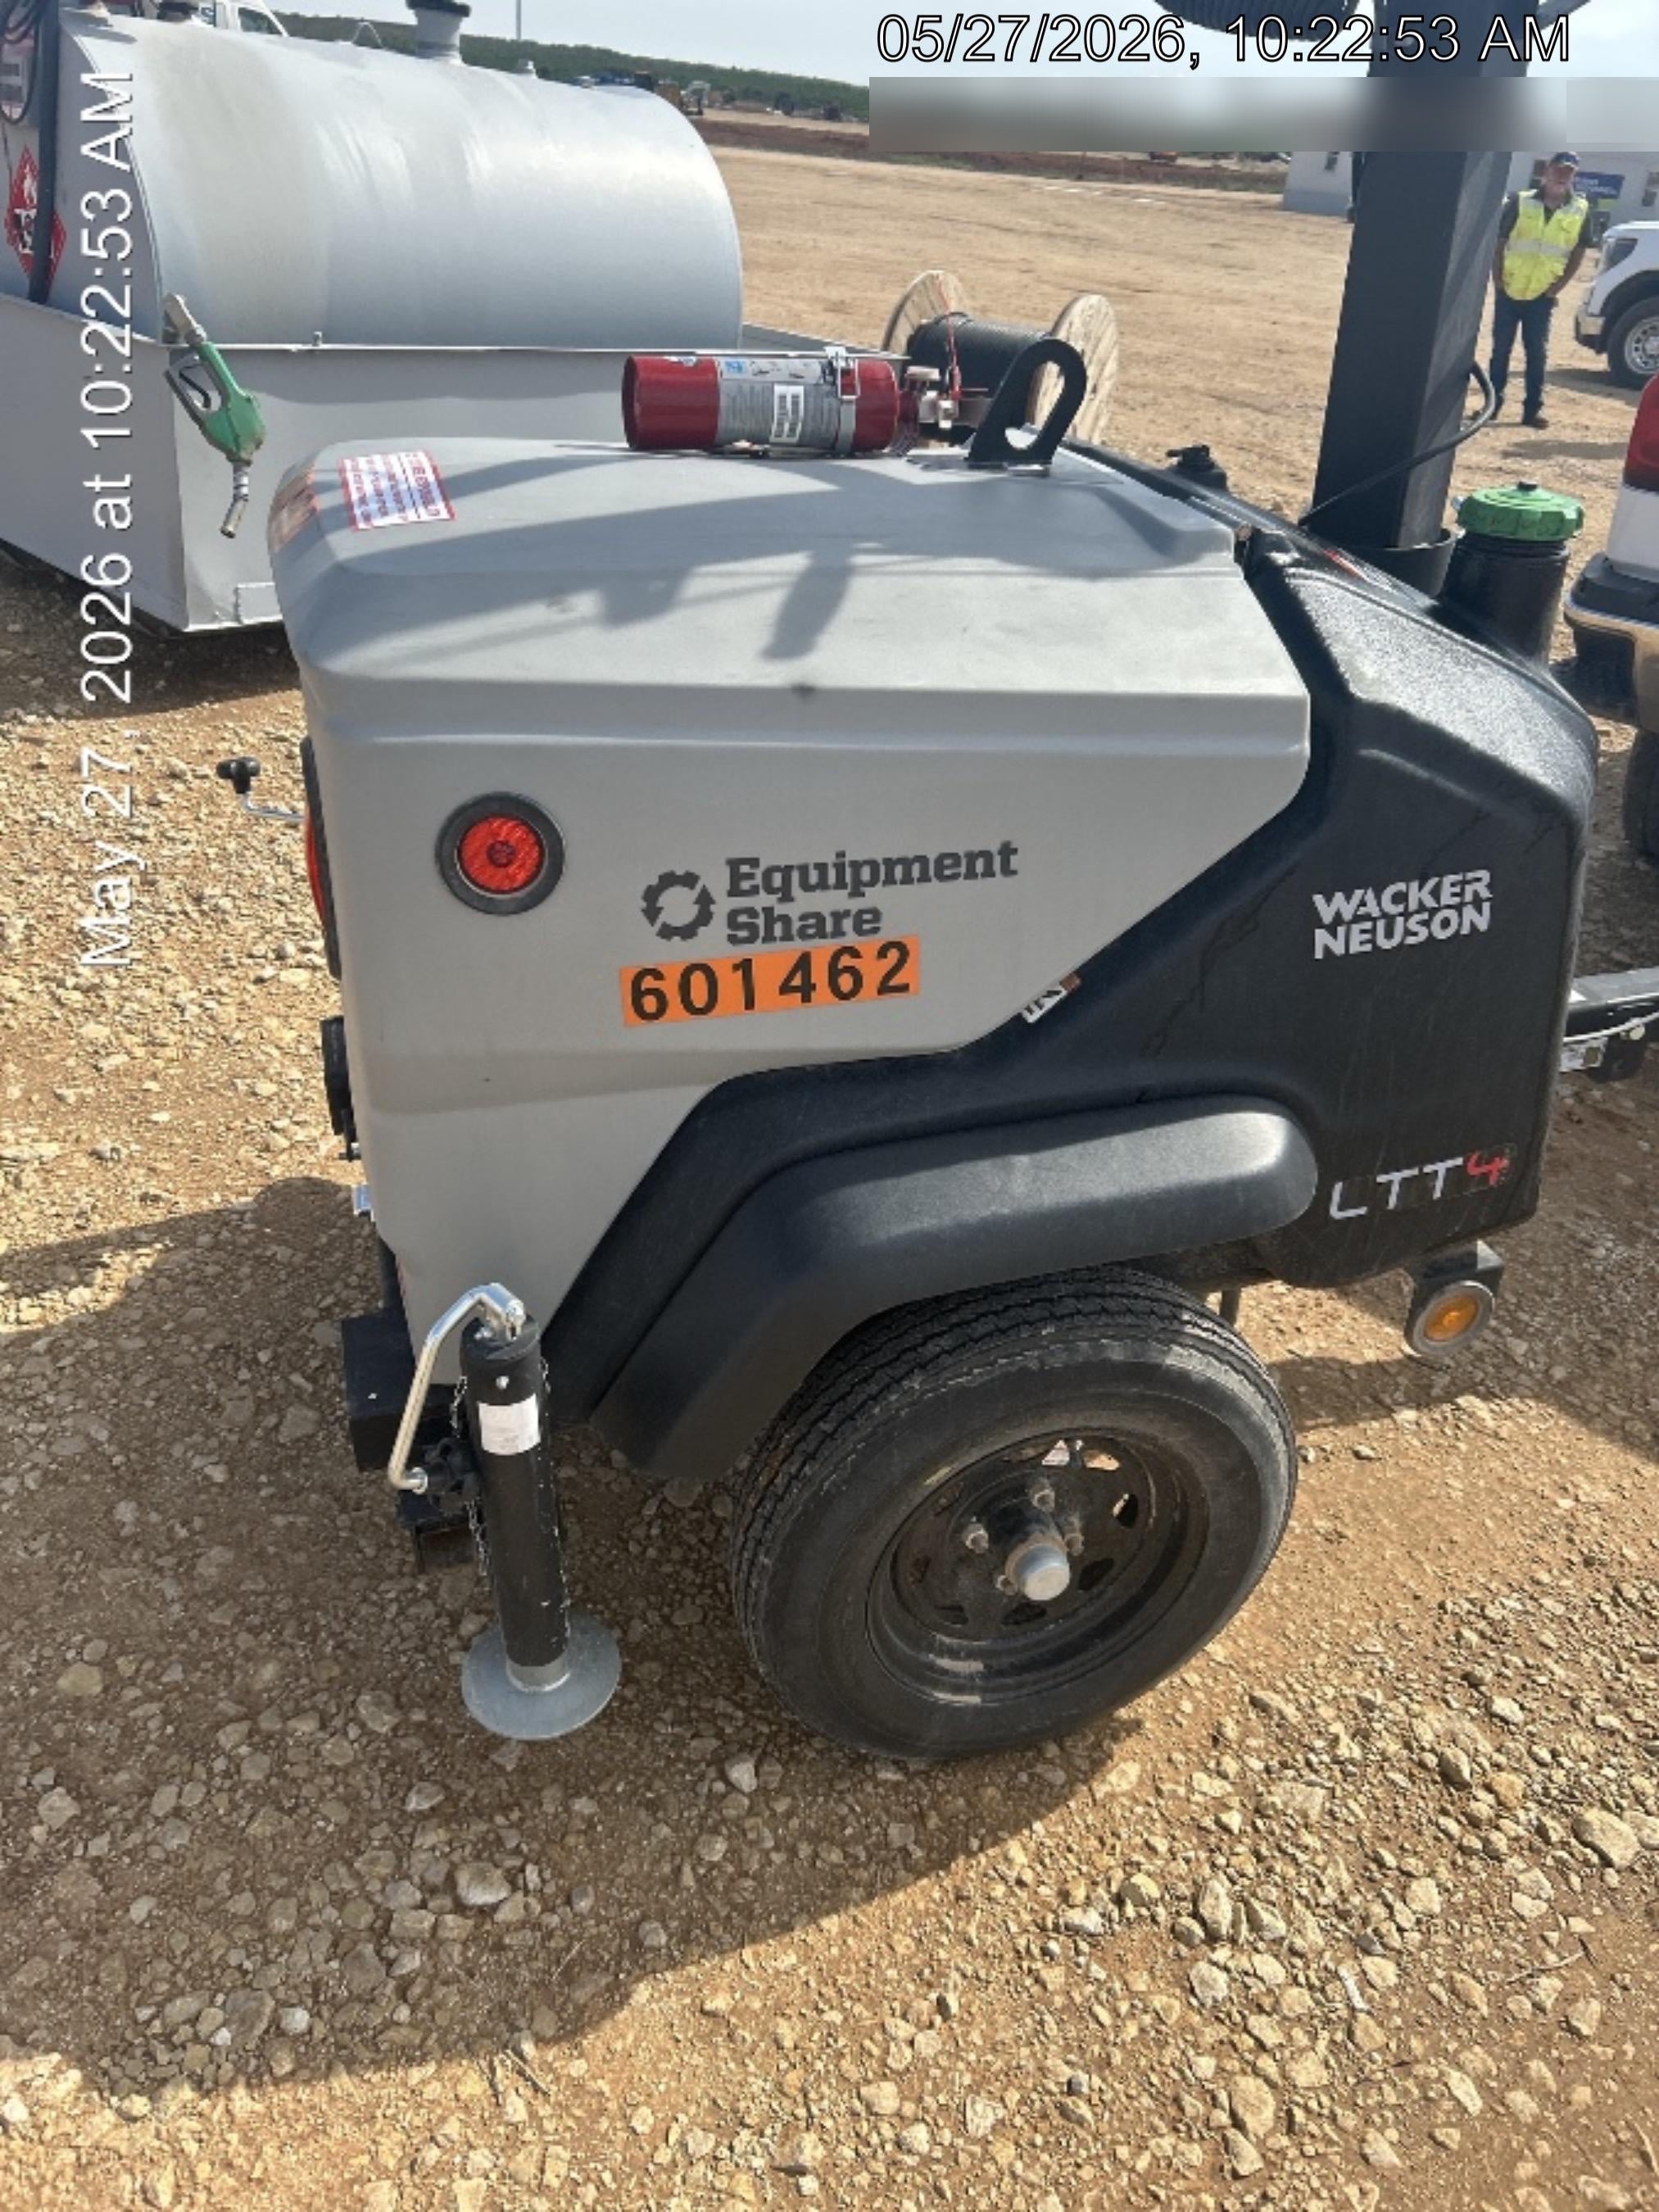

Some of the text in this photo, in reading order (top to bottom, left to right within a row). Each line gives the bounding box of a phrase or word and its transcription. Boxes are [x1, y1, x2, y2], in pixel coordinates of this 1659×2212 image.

[725, 840, 1018, 903] Equipment
[1312, 868, 1494, 925] WACKER
[726, 905, 884, 946] Share
[1314, 901, 1491, 959] NEUSON
[630, 940, 911, 1022] 601462
[1329, 1151, 1510, 1221] LTT4
